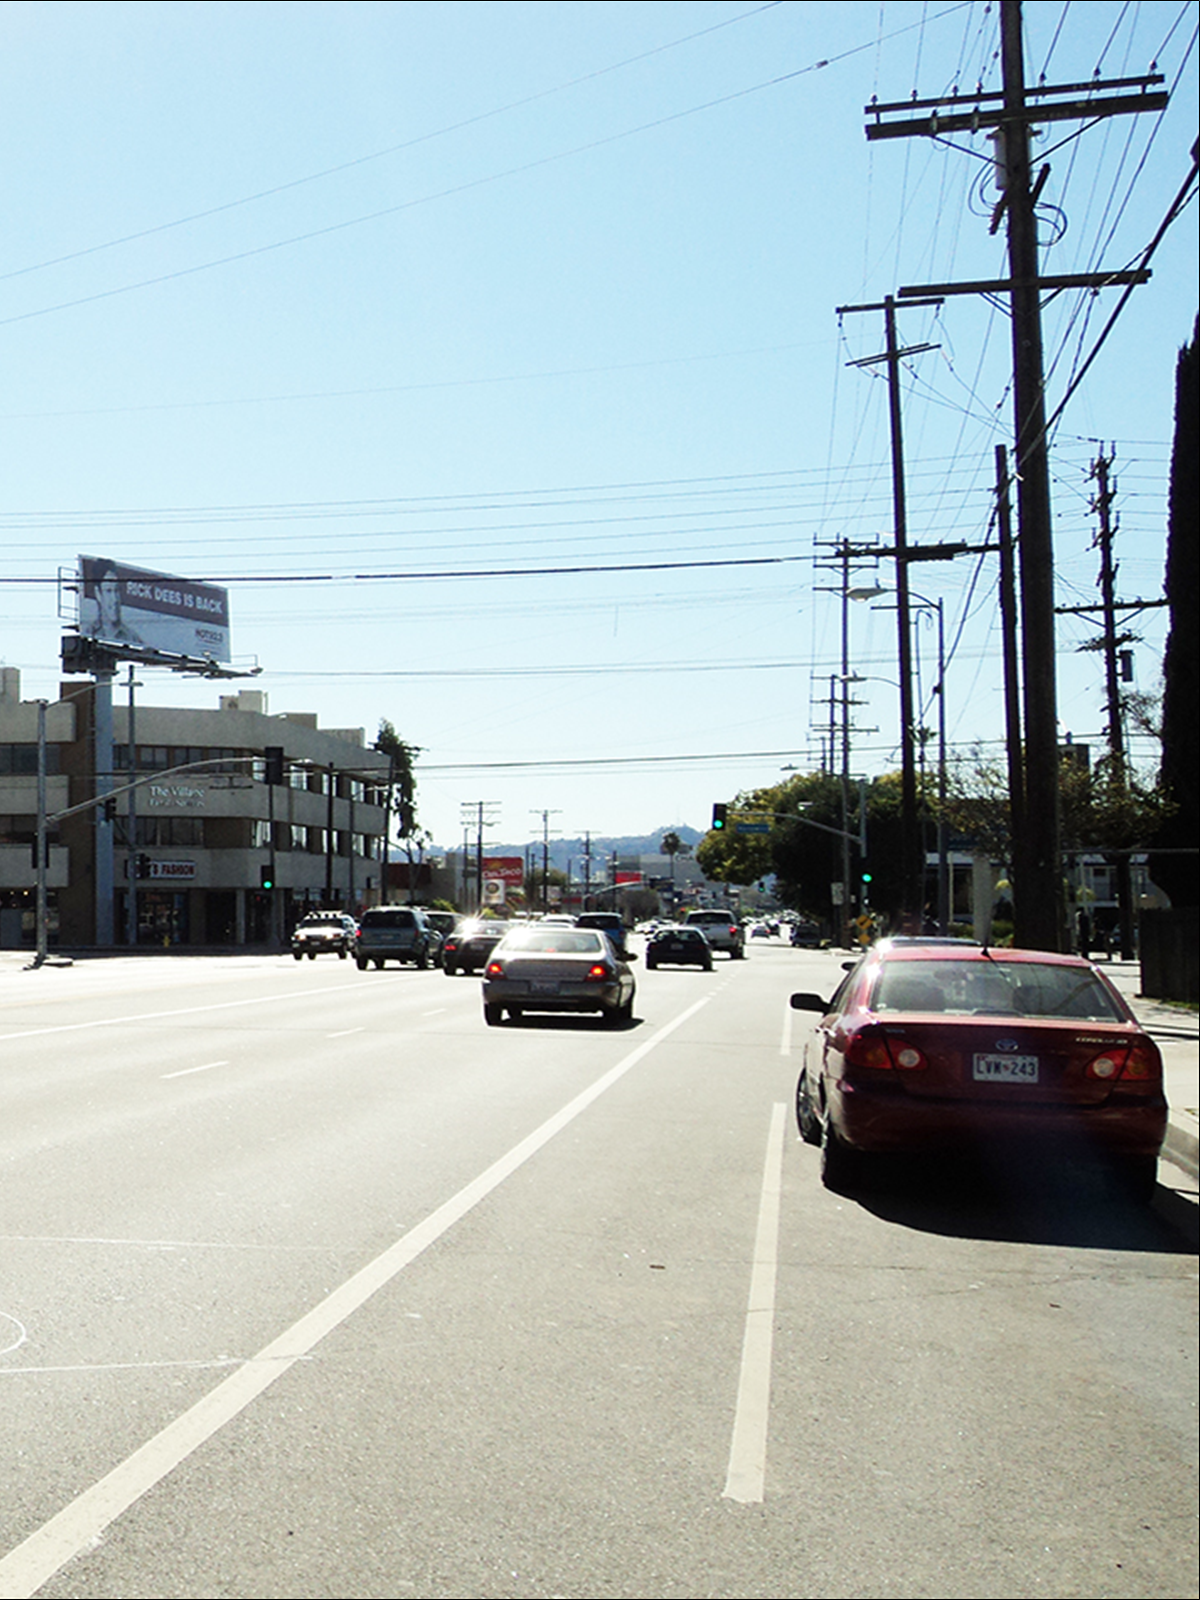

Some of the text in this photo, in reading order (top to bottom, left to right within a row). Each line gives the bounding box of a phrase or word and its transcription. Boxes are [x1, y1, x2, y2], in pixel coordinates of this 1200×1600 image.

[126, 581, 223, 614] RICK DEES IS BACK
[150, 786, 169, 797] The
[161, 864, 195, 876] FASHION
[1010, 1061, 1036, 1077] 243
